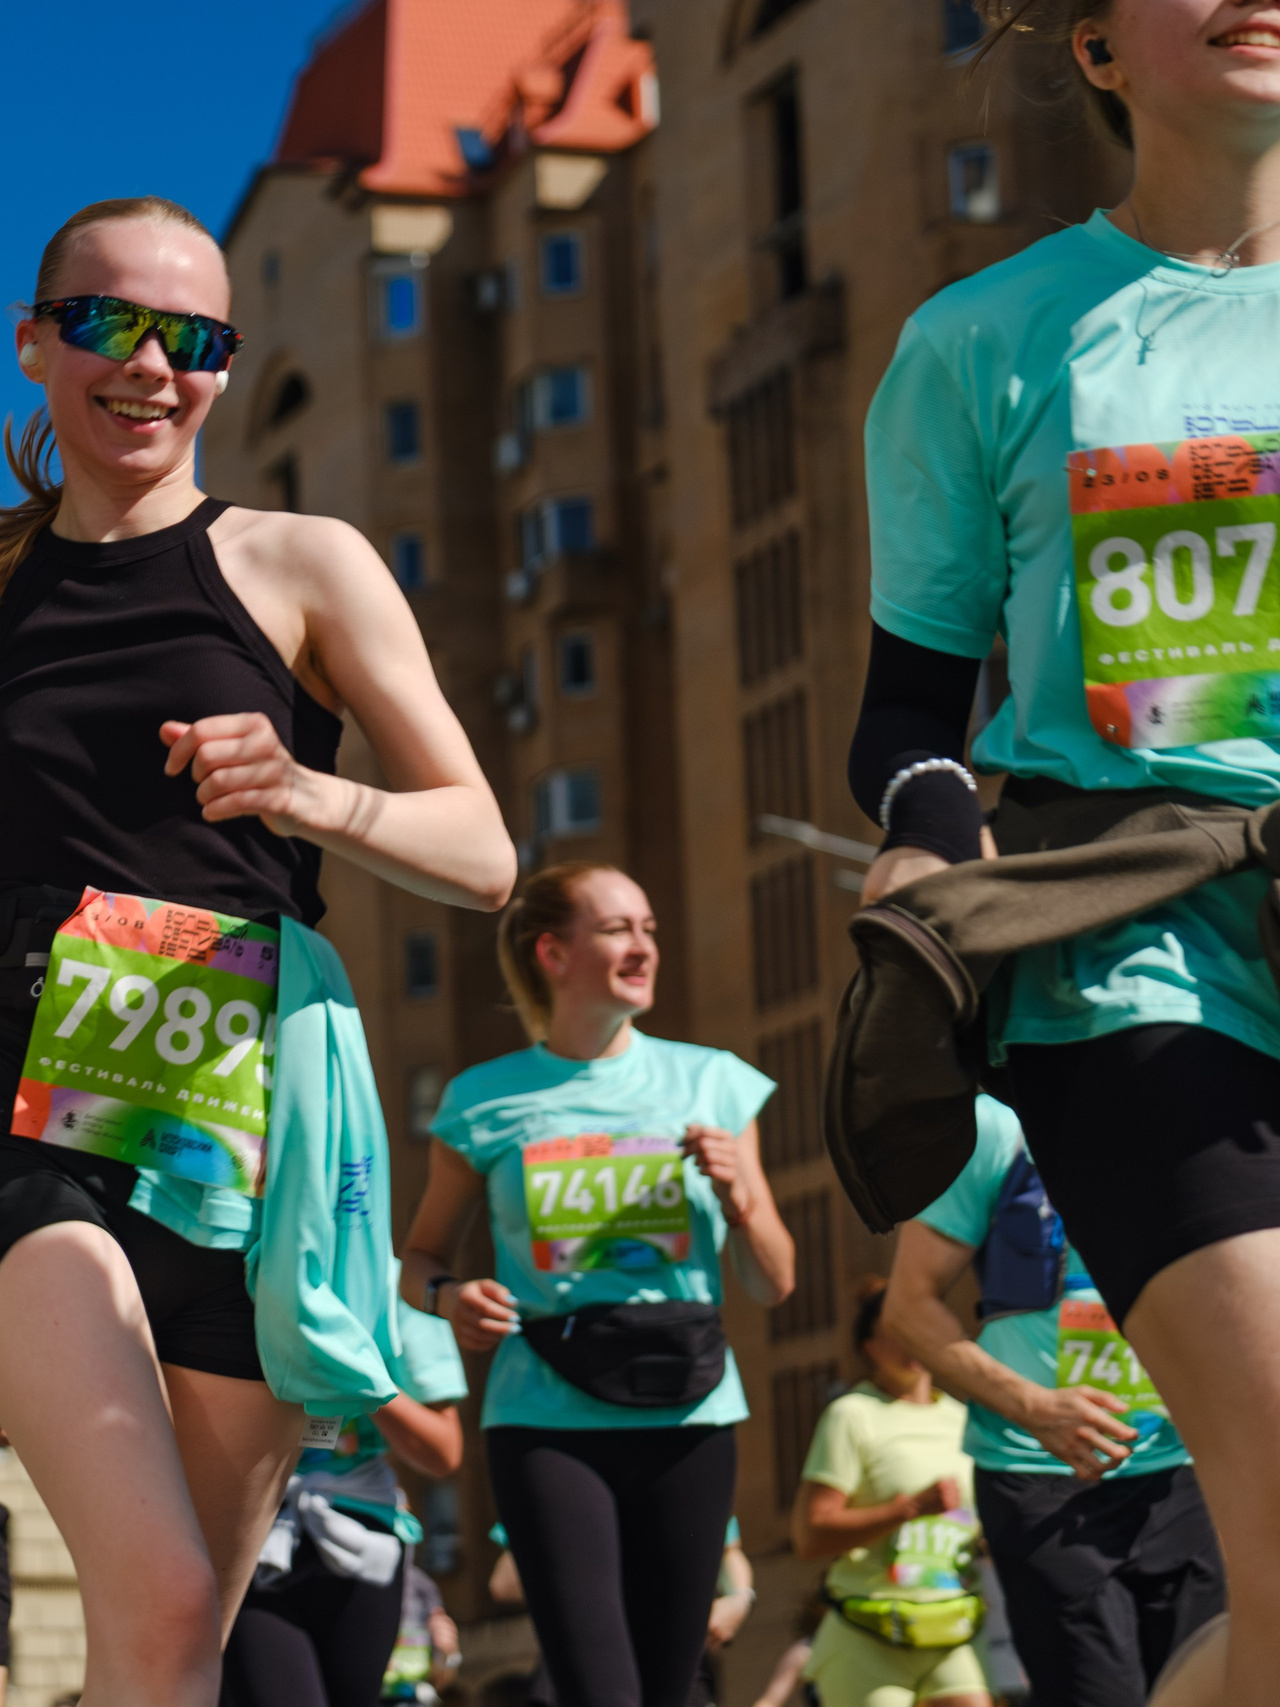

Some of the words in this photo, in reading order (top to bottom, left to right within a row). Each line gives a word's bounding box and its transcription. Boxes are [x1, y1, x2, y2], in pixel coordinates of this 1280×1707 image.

[1088, 522, 1277, 628] 807
[1098, 640, 1254, 666] ФЕСТИВАЛЬ
[38, 1056, 167, 1094] ФЕСТИВАЛЬ
[175, 1088, 265, 1121] ДВИЖЕН
[532, 1162, 682, 1217] 74146
[1062, 1339, 1148, 1386] 741
